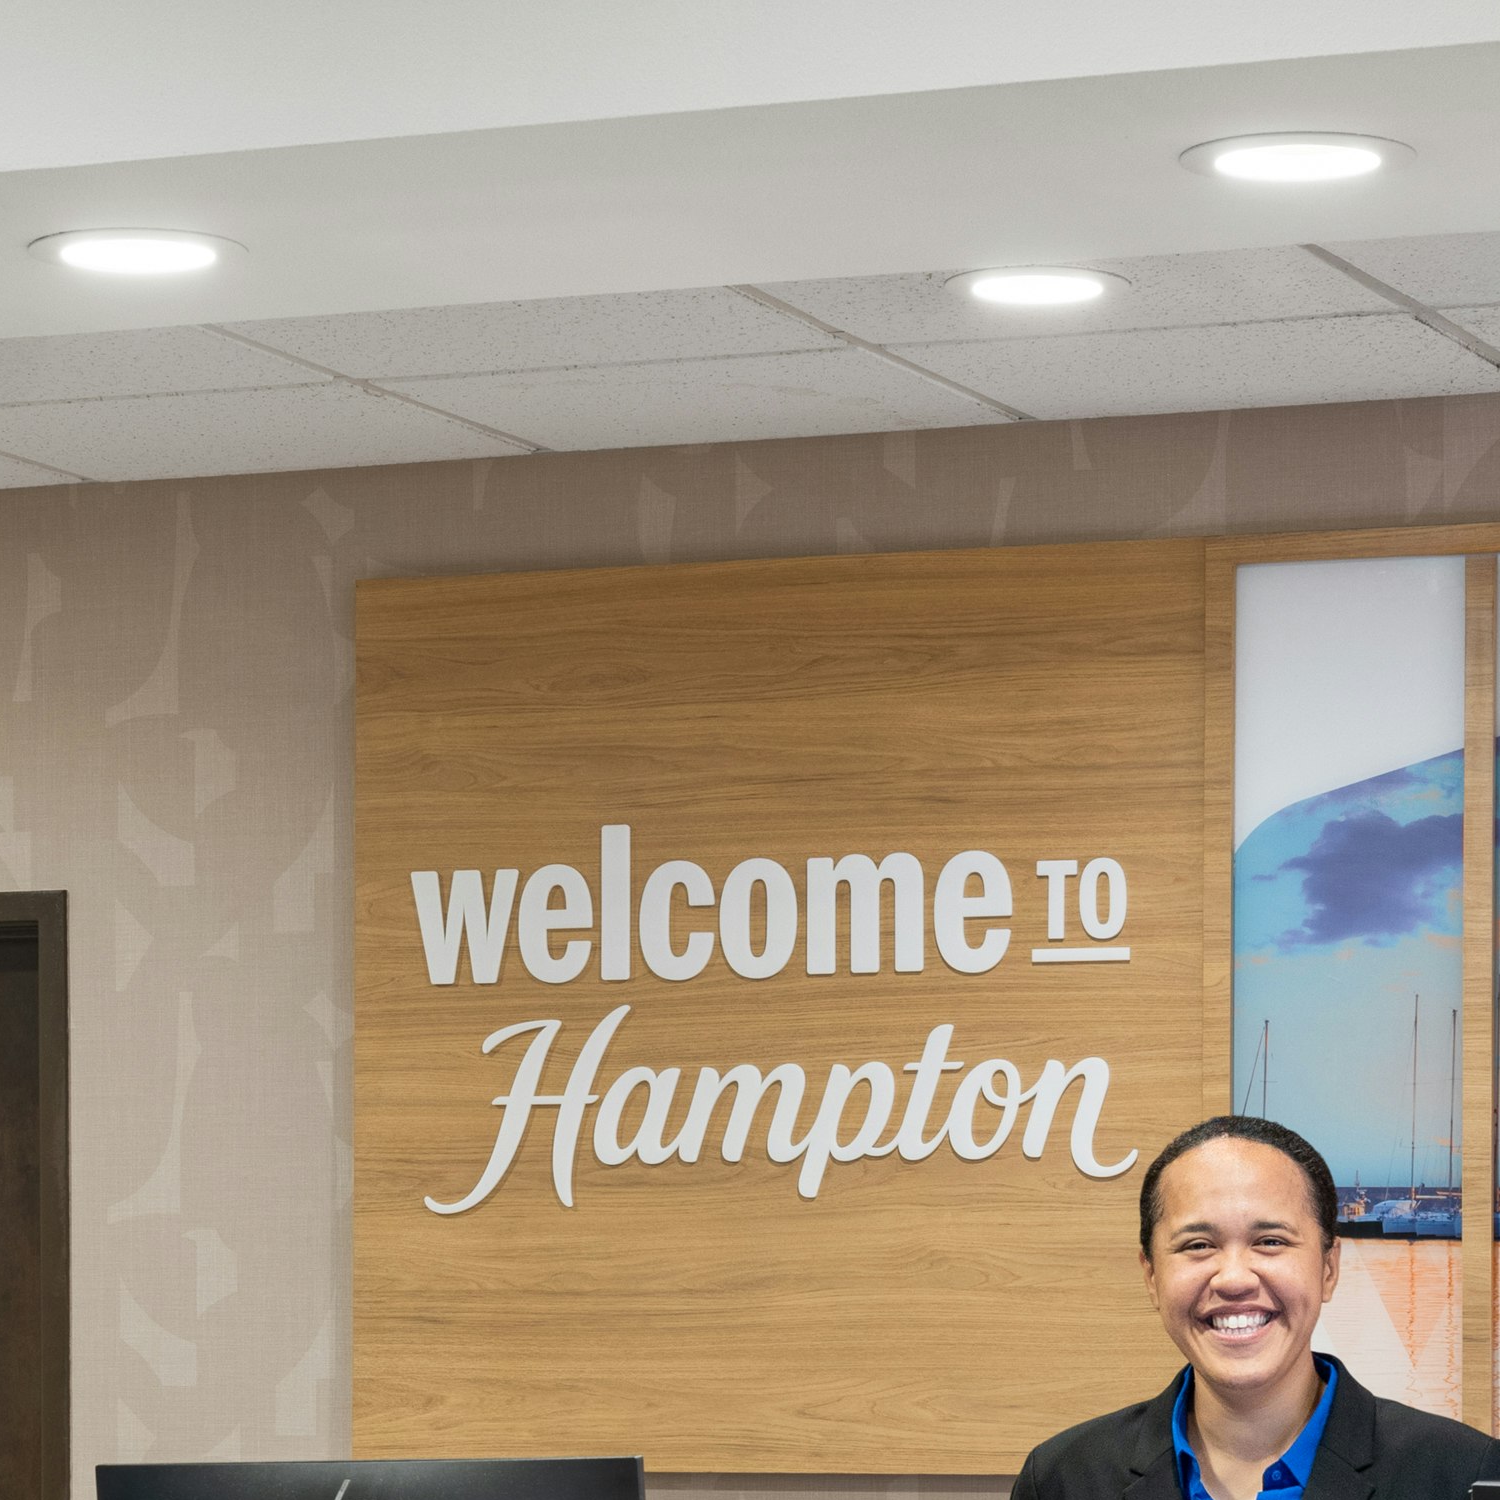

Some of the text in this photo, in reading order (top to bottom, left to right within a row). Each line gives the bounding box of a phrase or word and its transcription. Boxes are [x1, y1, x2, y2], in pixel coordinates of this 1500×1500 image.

[411, 825, 1128, 985] welcome TO
[424, 1005, 1139, 1214] Hampton
